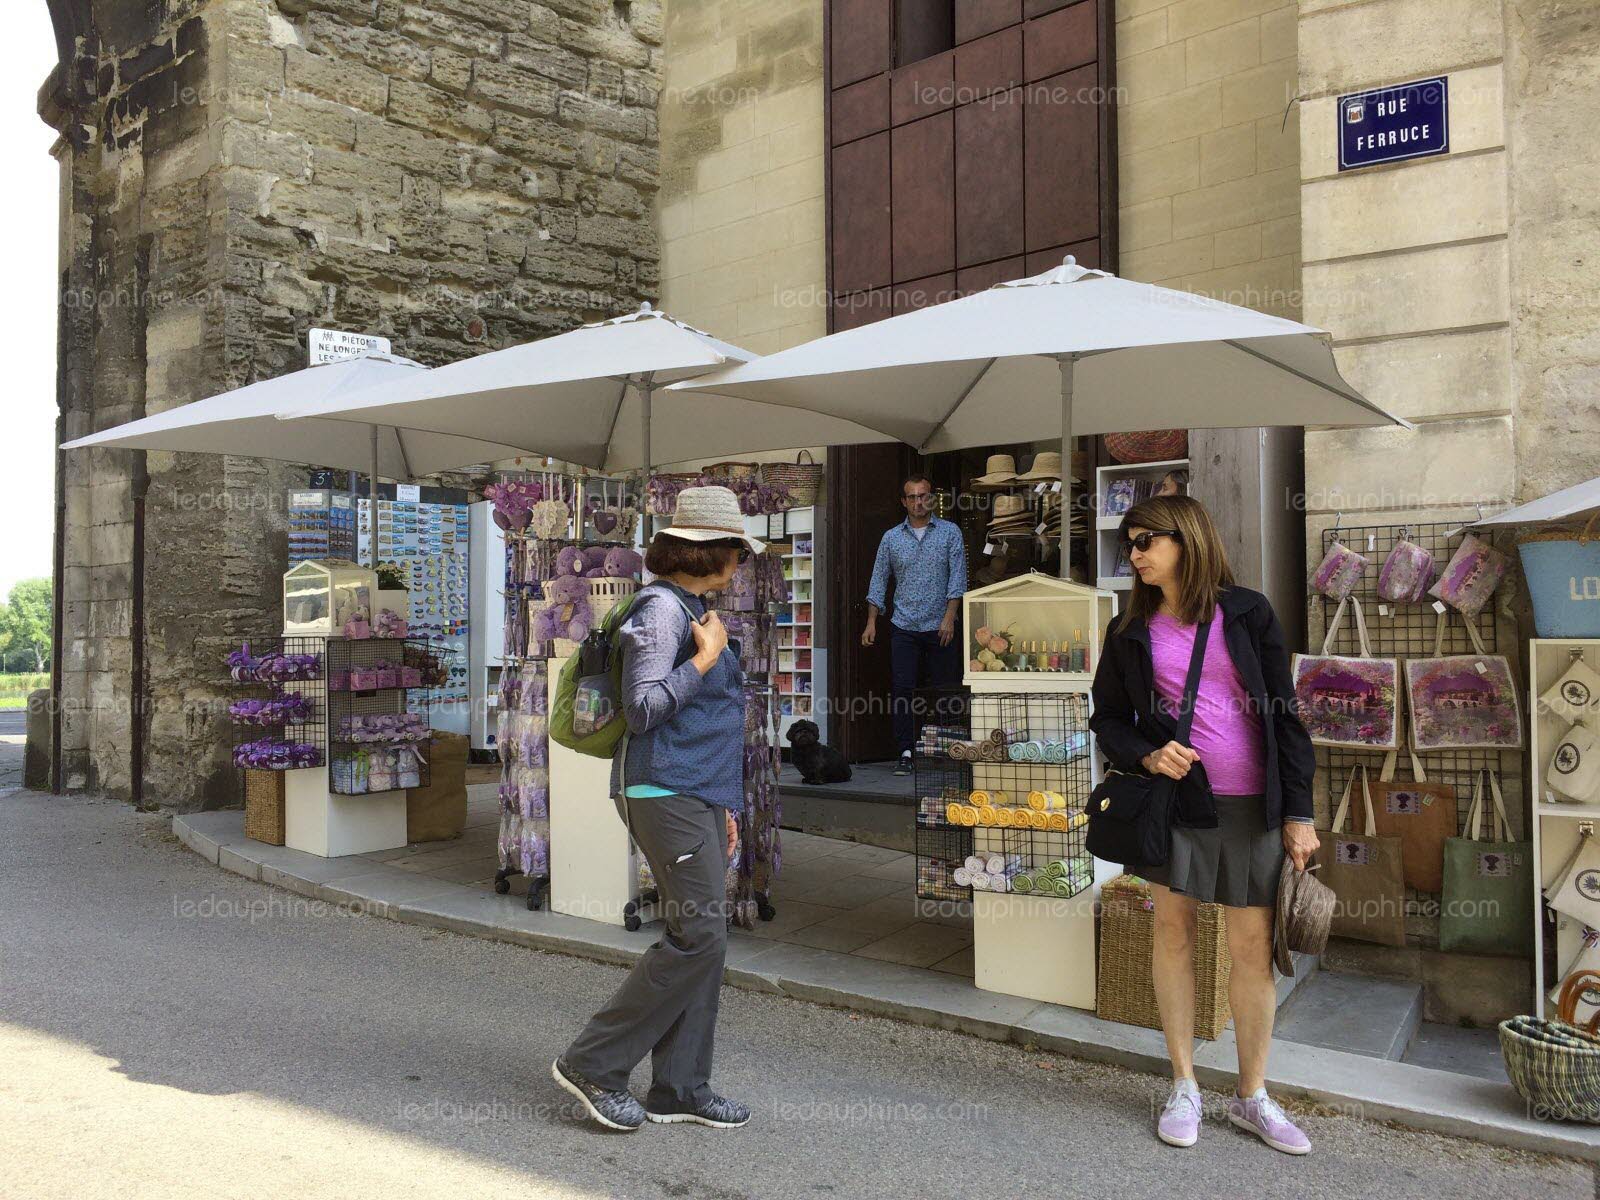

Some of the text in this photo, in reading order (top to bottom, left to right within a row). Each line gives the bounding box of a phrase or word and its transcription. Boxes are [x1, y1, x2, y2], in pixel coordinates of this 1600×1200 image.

[1377, 98, 1407, 117] RUE
[1357, 124, 1430, 151] FERRUCE
[318, 343, 366, 355] NE LONGE
